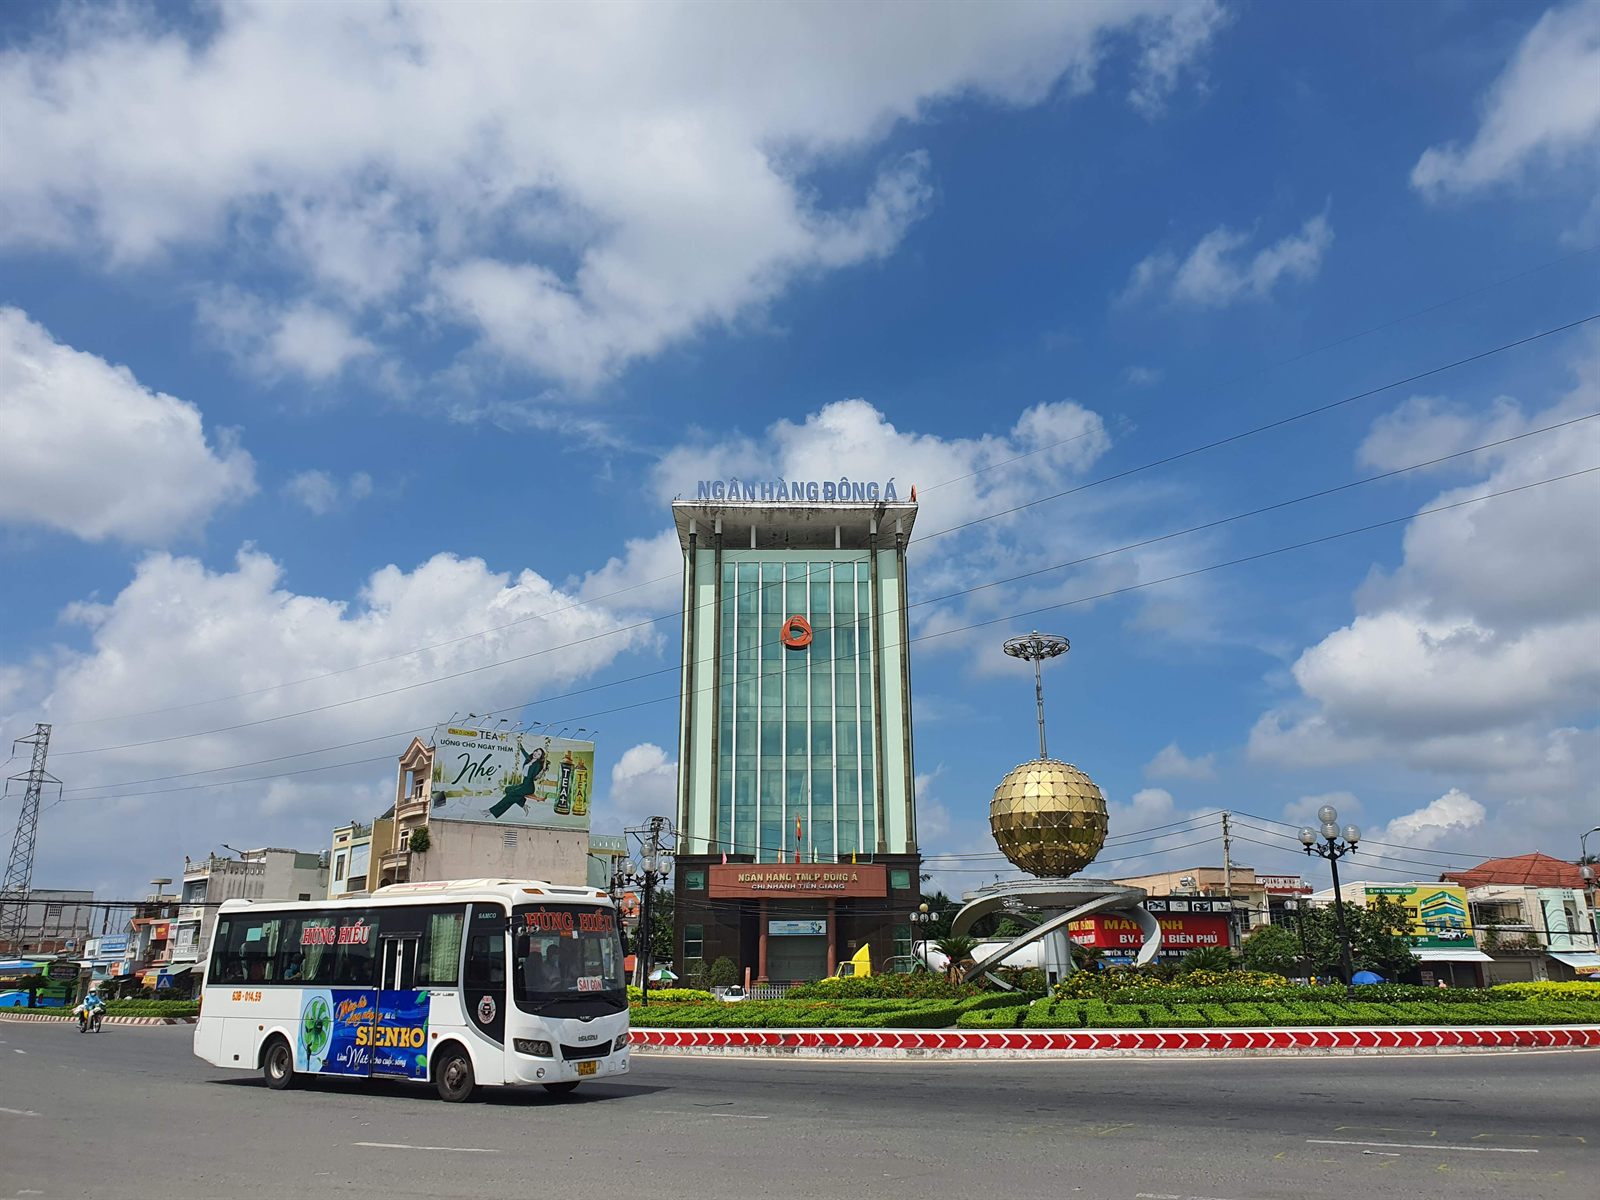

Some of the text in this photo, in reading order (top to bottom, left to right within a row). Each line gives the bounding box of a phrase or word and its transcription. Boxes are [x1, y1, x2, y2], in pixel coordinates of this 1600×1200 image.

[697, 477, 897, 501] NGÂN HÀNG ĐÔNG Á
[462, 741, 476, 749] CHO
[451, 753, 497, 784] Nhẹ
[738, 872, 858, 882] NGÂN HÀNG TMCP ĐÔNG Á
[525, 906, 614, 932] HÙNG HIẾU
[1159, 917, 1183, 930] ÍNH
[301, 917, 371, 945] HÙNG HIẾU
[1119, 934, 1138, 943] BV.
[1168, 932, 1194, 943] BIÊN
[1196, 931, 1218, 943] PHỦ
